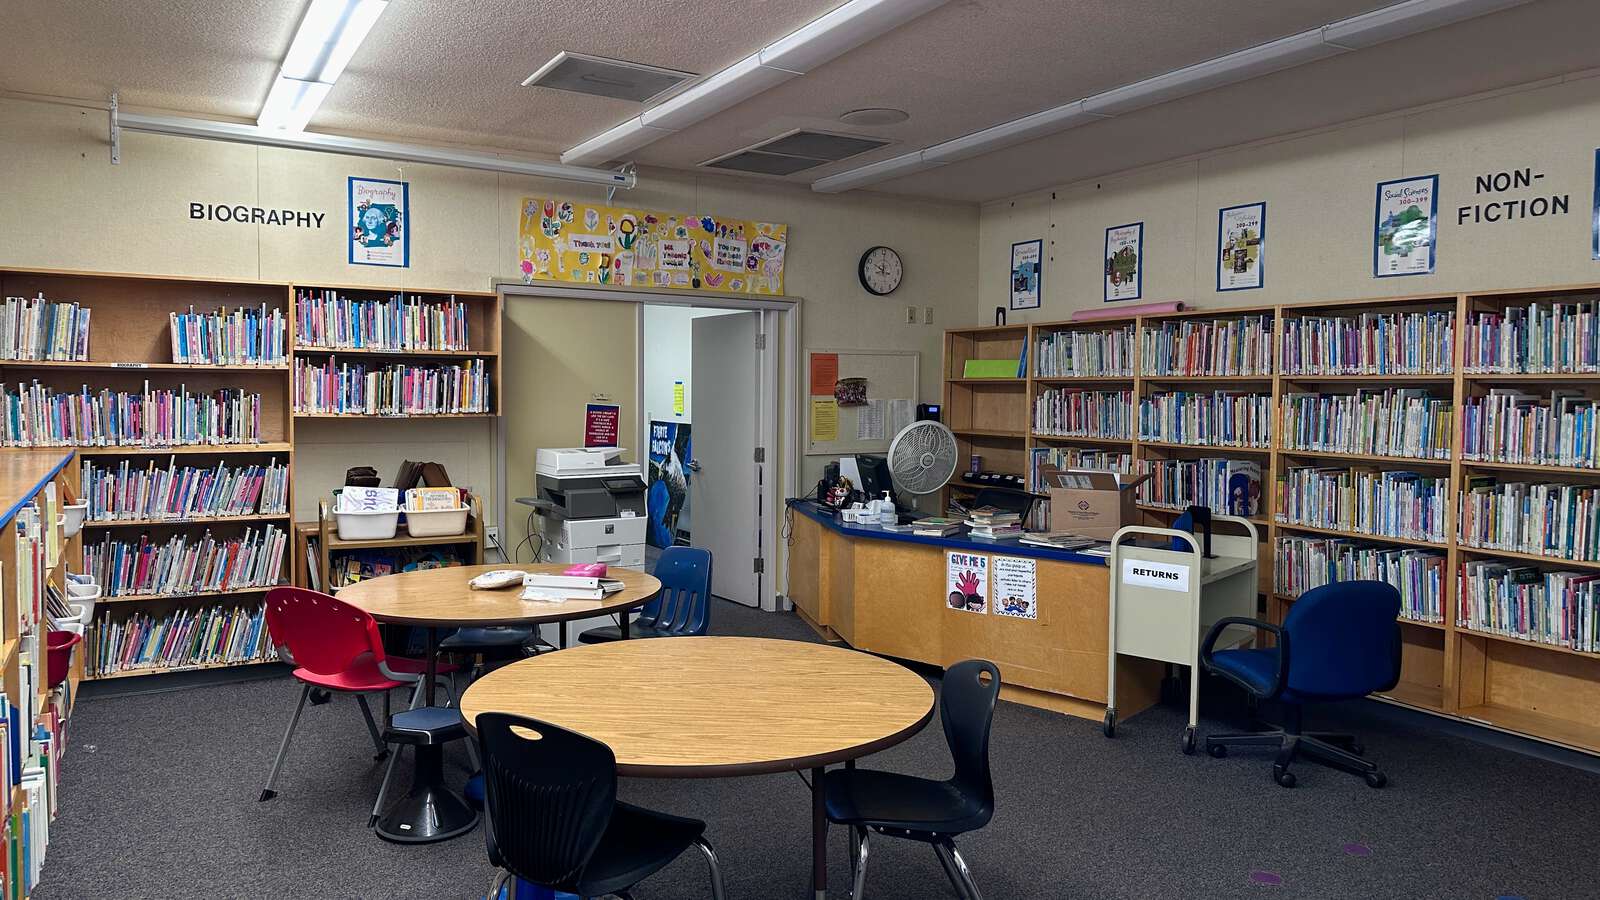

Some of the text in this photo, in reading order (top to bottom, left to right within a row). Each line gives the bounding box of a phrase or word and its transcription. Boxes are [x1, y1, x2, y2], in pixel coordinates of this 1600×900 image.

[1476, 168, 1544, 194] NON-
[357, 184, 396, 200] Biography
[1384, 186, 1428, 200] Social Sciences
[189, 202, 326, 228] BIOGRAPHY
[1458, 195, 1569, 225] FICTION
[652, 439, 671, 455] FALCONS
[952, 554, 985, 568] GIVE ME 5
[1132, 568, 1179, 580] RETURNS
